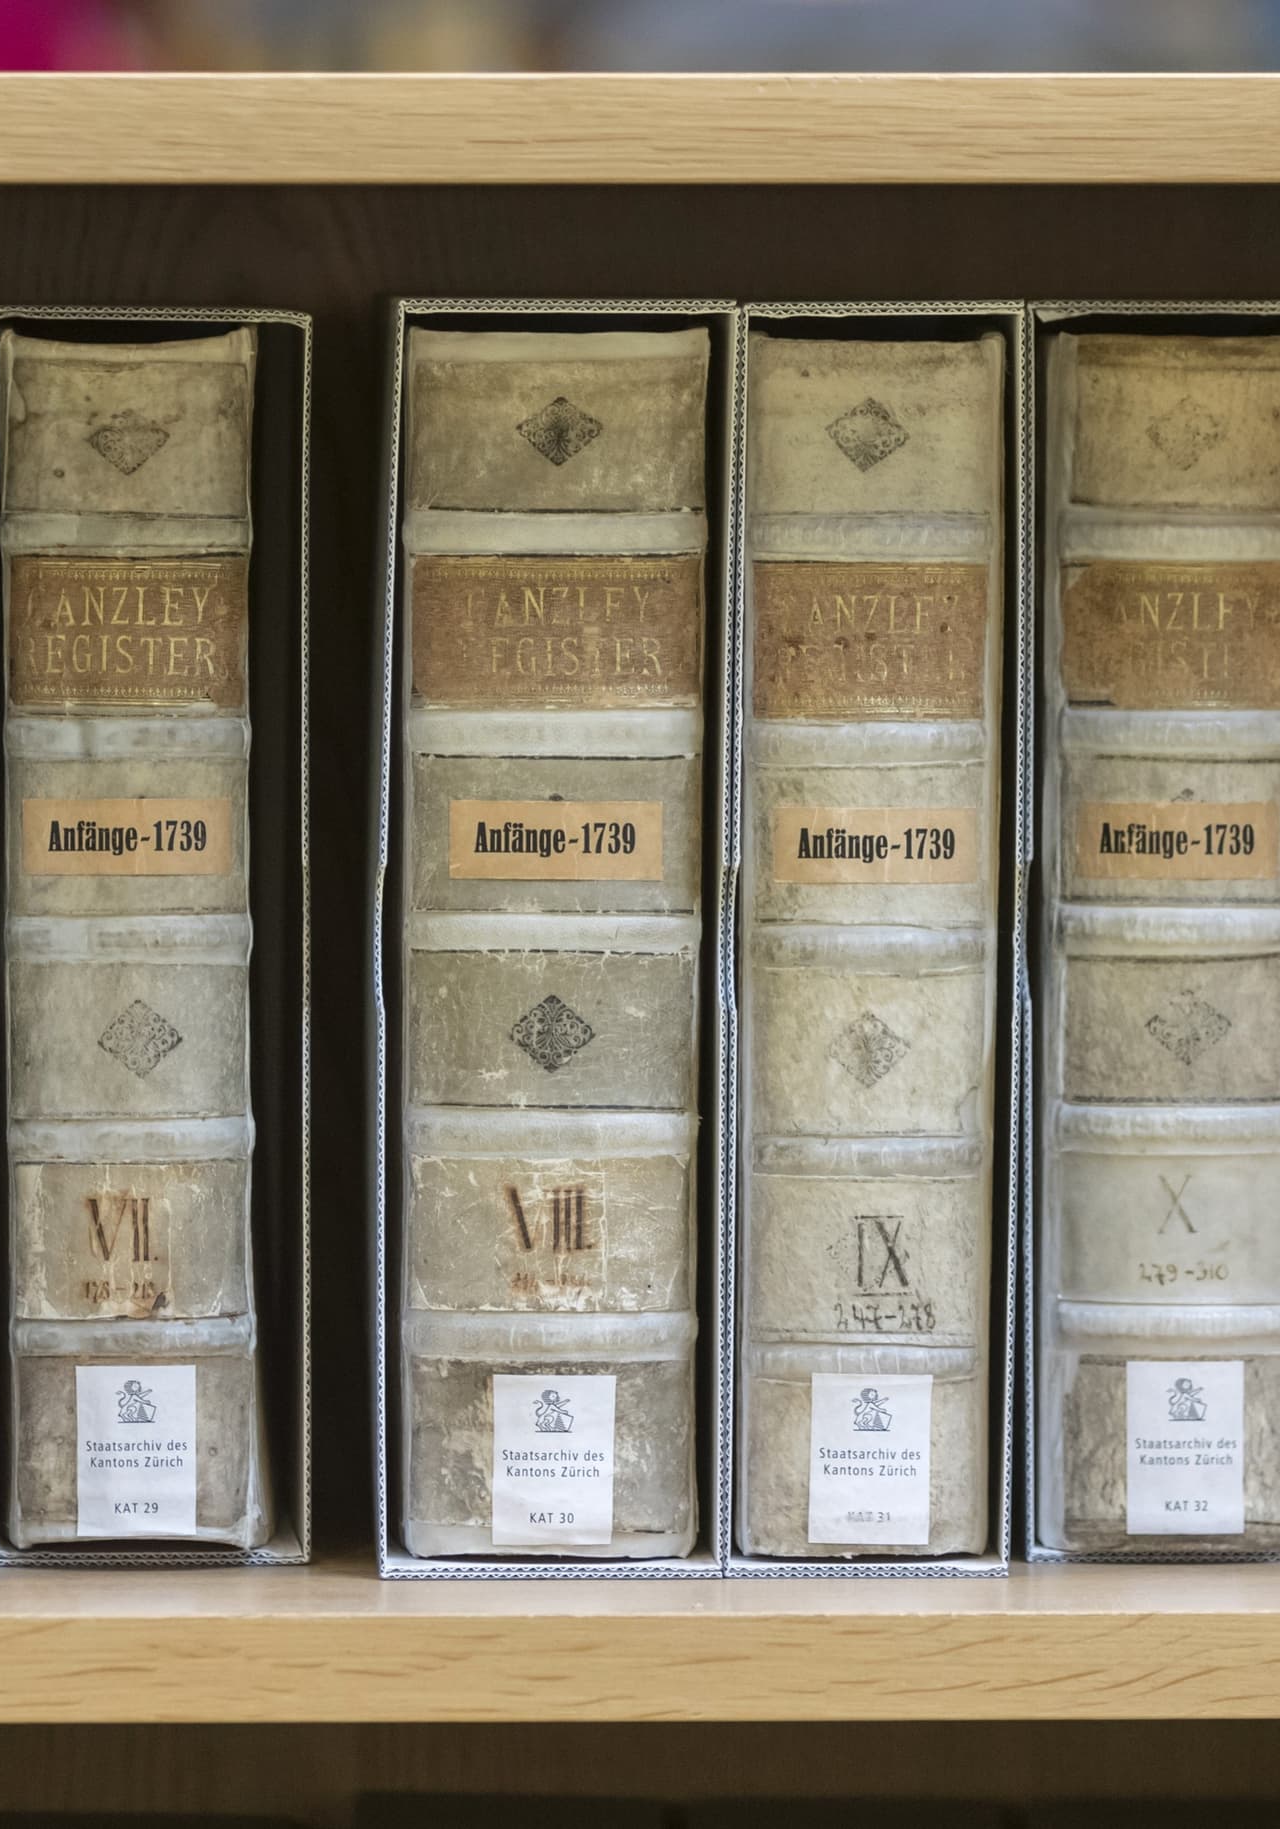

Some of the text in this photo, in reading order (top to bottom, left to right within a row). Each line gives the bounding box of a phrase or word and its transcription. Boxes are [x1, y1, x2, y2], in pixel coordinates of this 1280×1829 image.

[48, 821, 206, 855] Anfänge-1739
[474, 822, 635, 861] Anfänge-1739
[797, 828, 956, 864] Anfänge-1739
[1157, 1174, 1199, 1234] X
[87, 1197, 158, 1262] VII.
[854, 1216, 910, 1296] IX
[85, 1439, 188, 1453] Staatsarchiv des
[1135, 1437, 1238, 1450] Staatsarchiv des
[502, 1449, 605, 1462] Staatsarchiv des
[819, 1447, 922, 1460] Staatsarchiv des
[1140, 1453, 1233, 1466] Kantons Zürich
[90, 1455, 183, 1469] Kantons Zürich
[506, 1464, 600, 1478] Kantons Zürich
[823, 1463, 917, 1477] Kantons Zürich
[114, 1501, 159, 1514] KAT 29
[1165, 1499, 1208, 1512] KAT 32
[528, 1512, 575, 1525] KAT 30
[847, 1511, 891, 1523] KAT 31
